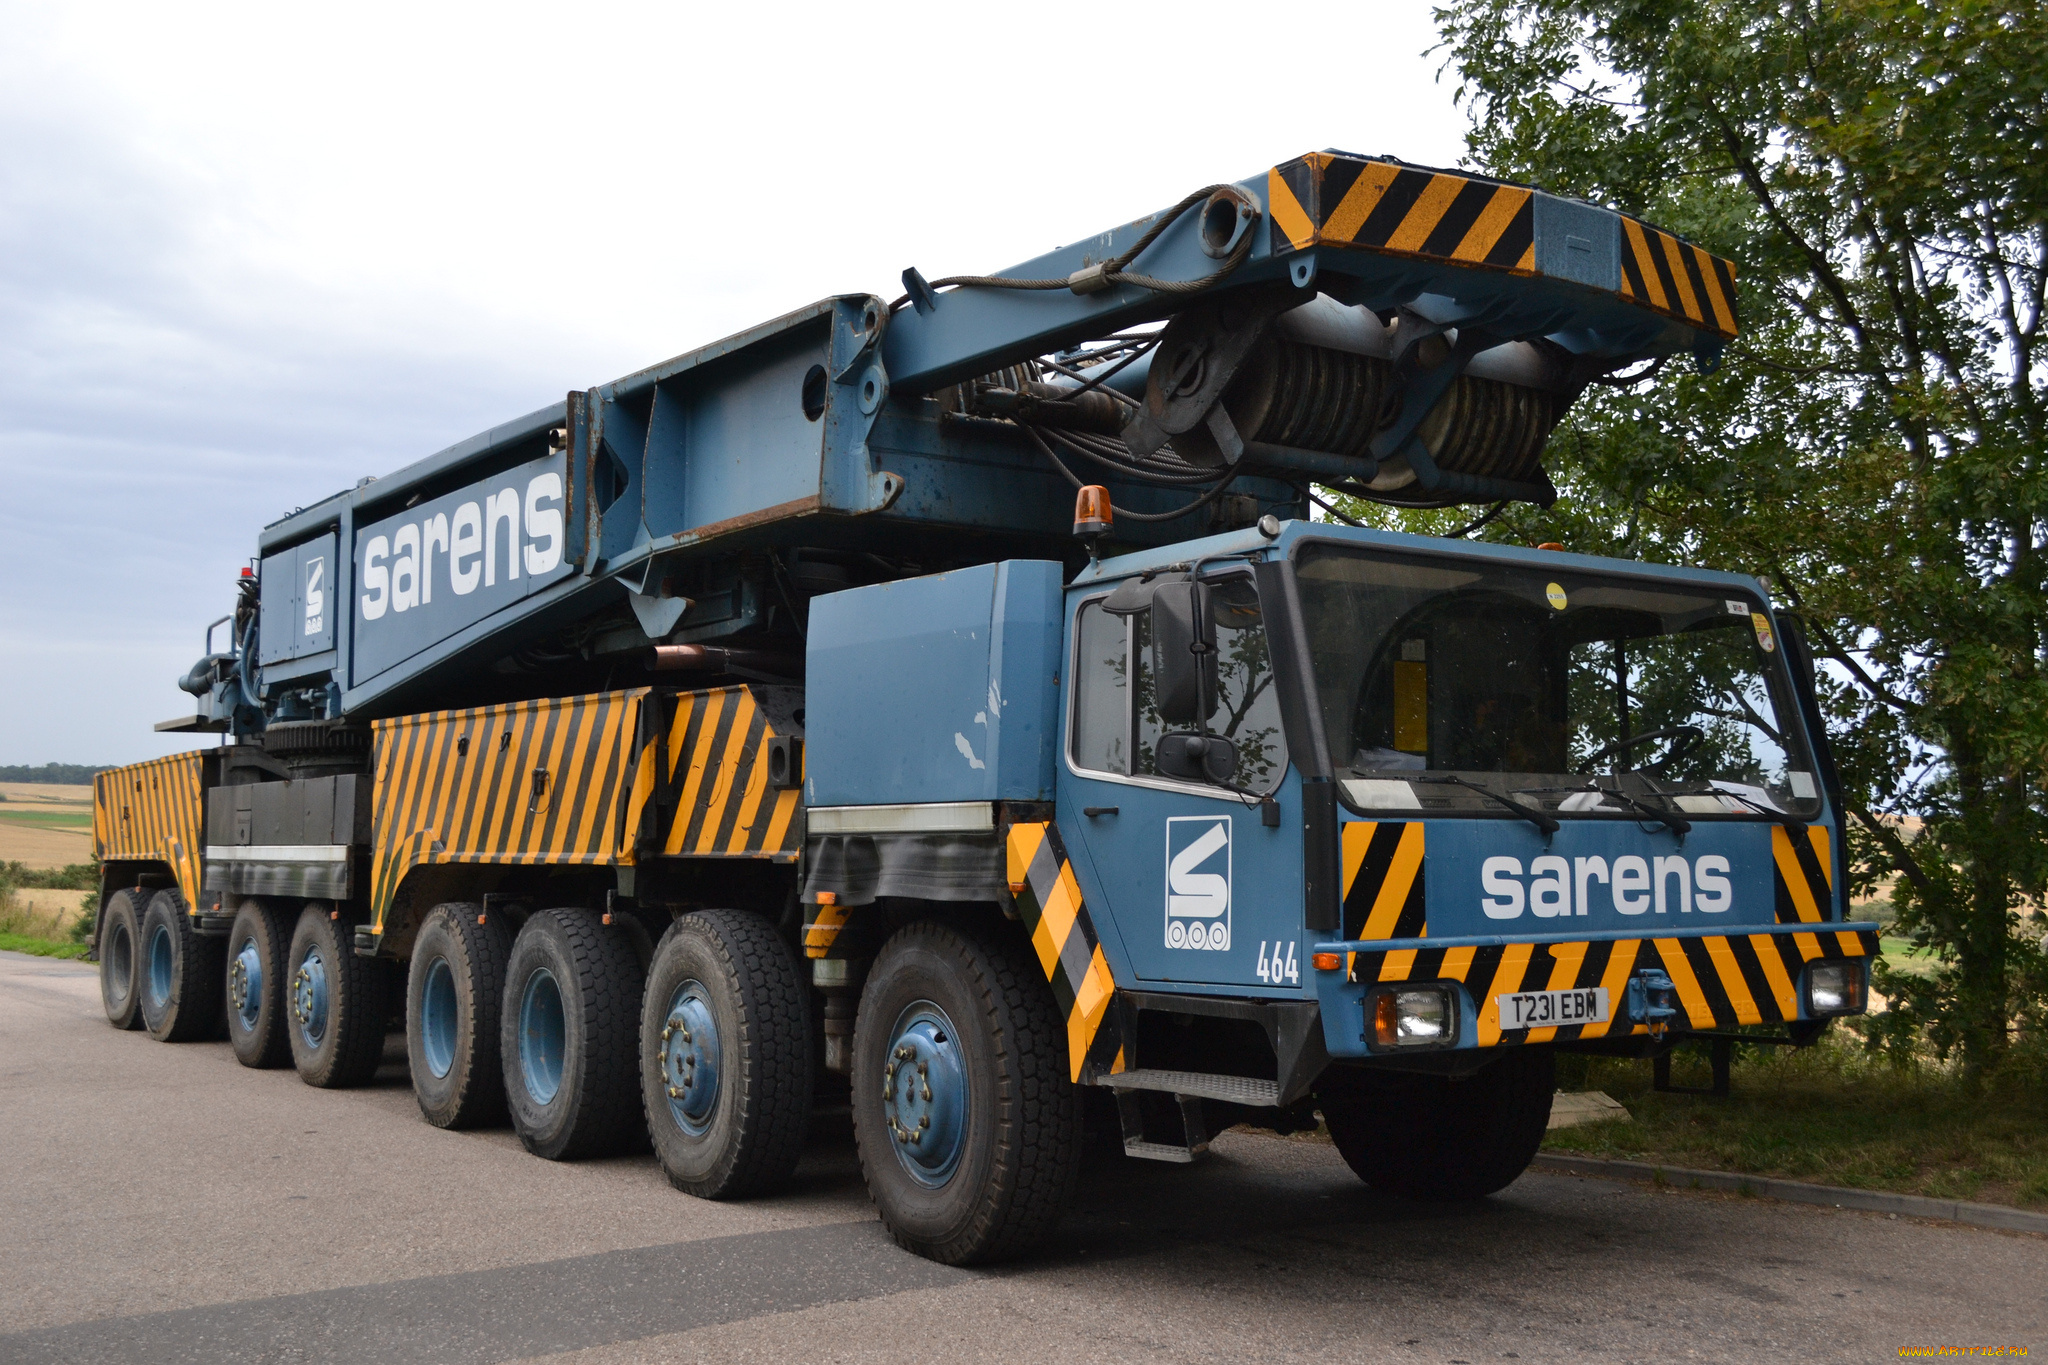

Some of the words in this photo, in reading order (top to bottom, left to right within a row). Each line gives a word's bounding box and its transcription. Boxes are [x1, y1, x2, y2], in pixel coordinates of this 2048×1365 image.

[361, 471, 564, 621] sarens
[1481, 855, 1732, 919] sarens
[1256, 940, 1299, 985] 464
[1511, 994, 1555, 1023] T231
[1561, 991, 1597, 1020] EBM
